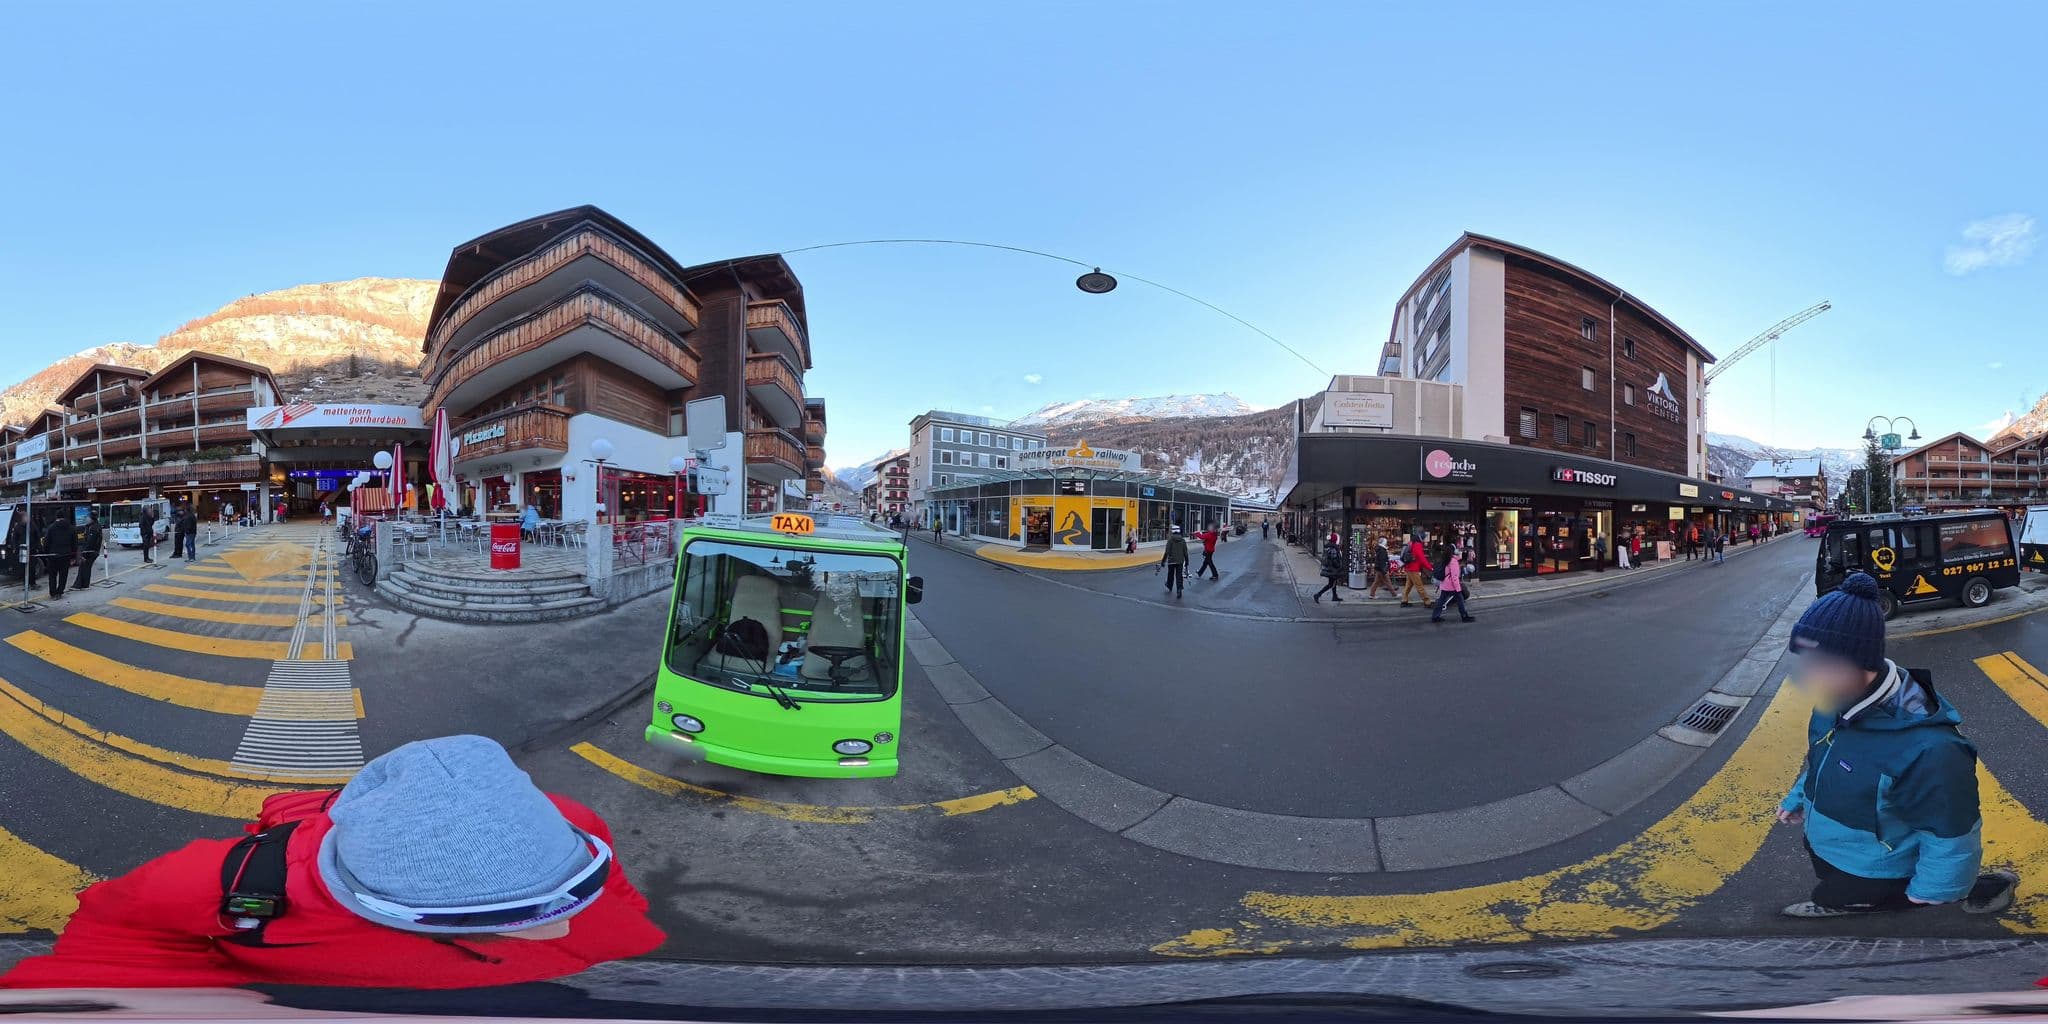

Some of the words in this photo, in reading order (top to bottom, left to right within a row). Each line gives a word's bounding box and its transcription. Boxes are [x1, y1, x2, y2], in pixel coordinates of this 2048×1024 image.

[1647, 391, 1679, 415] VIKTORIA
[323, 407, 372, 416] matterhorn
[1647, 403, 1680, 424] CENTER
[349, 415, 385, 425] gotthard
[463, 424, 505, 446] Pizzeria
[1018, 449, 1066, 462] gornergrat
[1096, 449, 1129, 463] railway
[1573, 469, 1617, 486] TISSOT
[1500, 496, 1531, 505] TISSOT
[774, 516, 810, 532] TAXI
[1943, 565, 1963, 576] 027
[1966, 562, 1984, 573] 967
[1988, 560, 2000, 569] 12
[2003, 558, 2014, 567] 12
